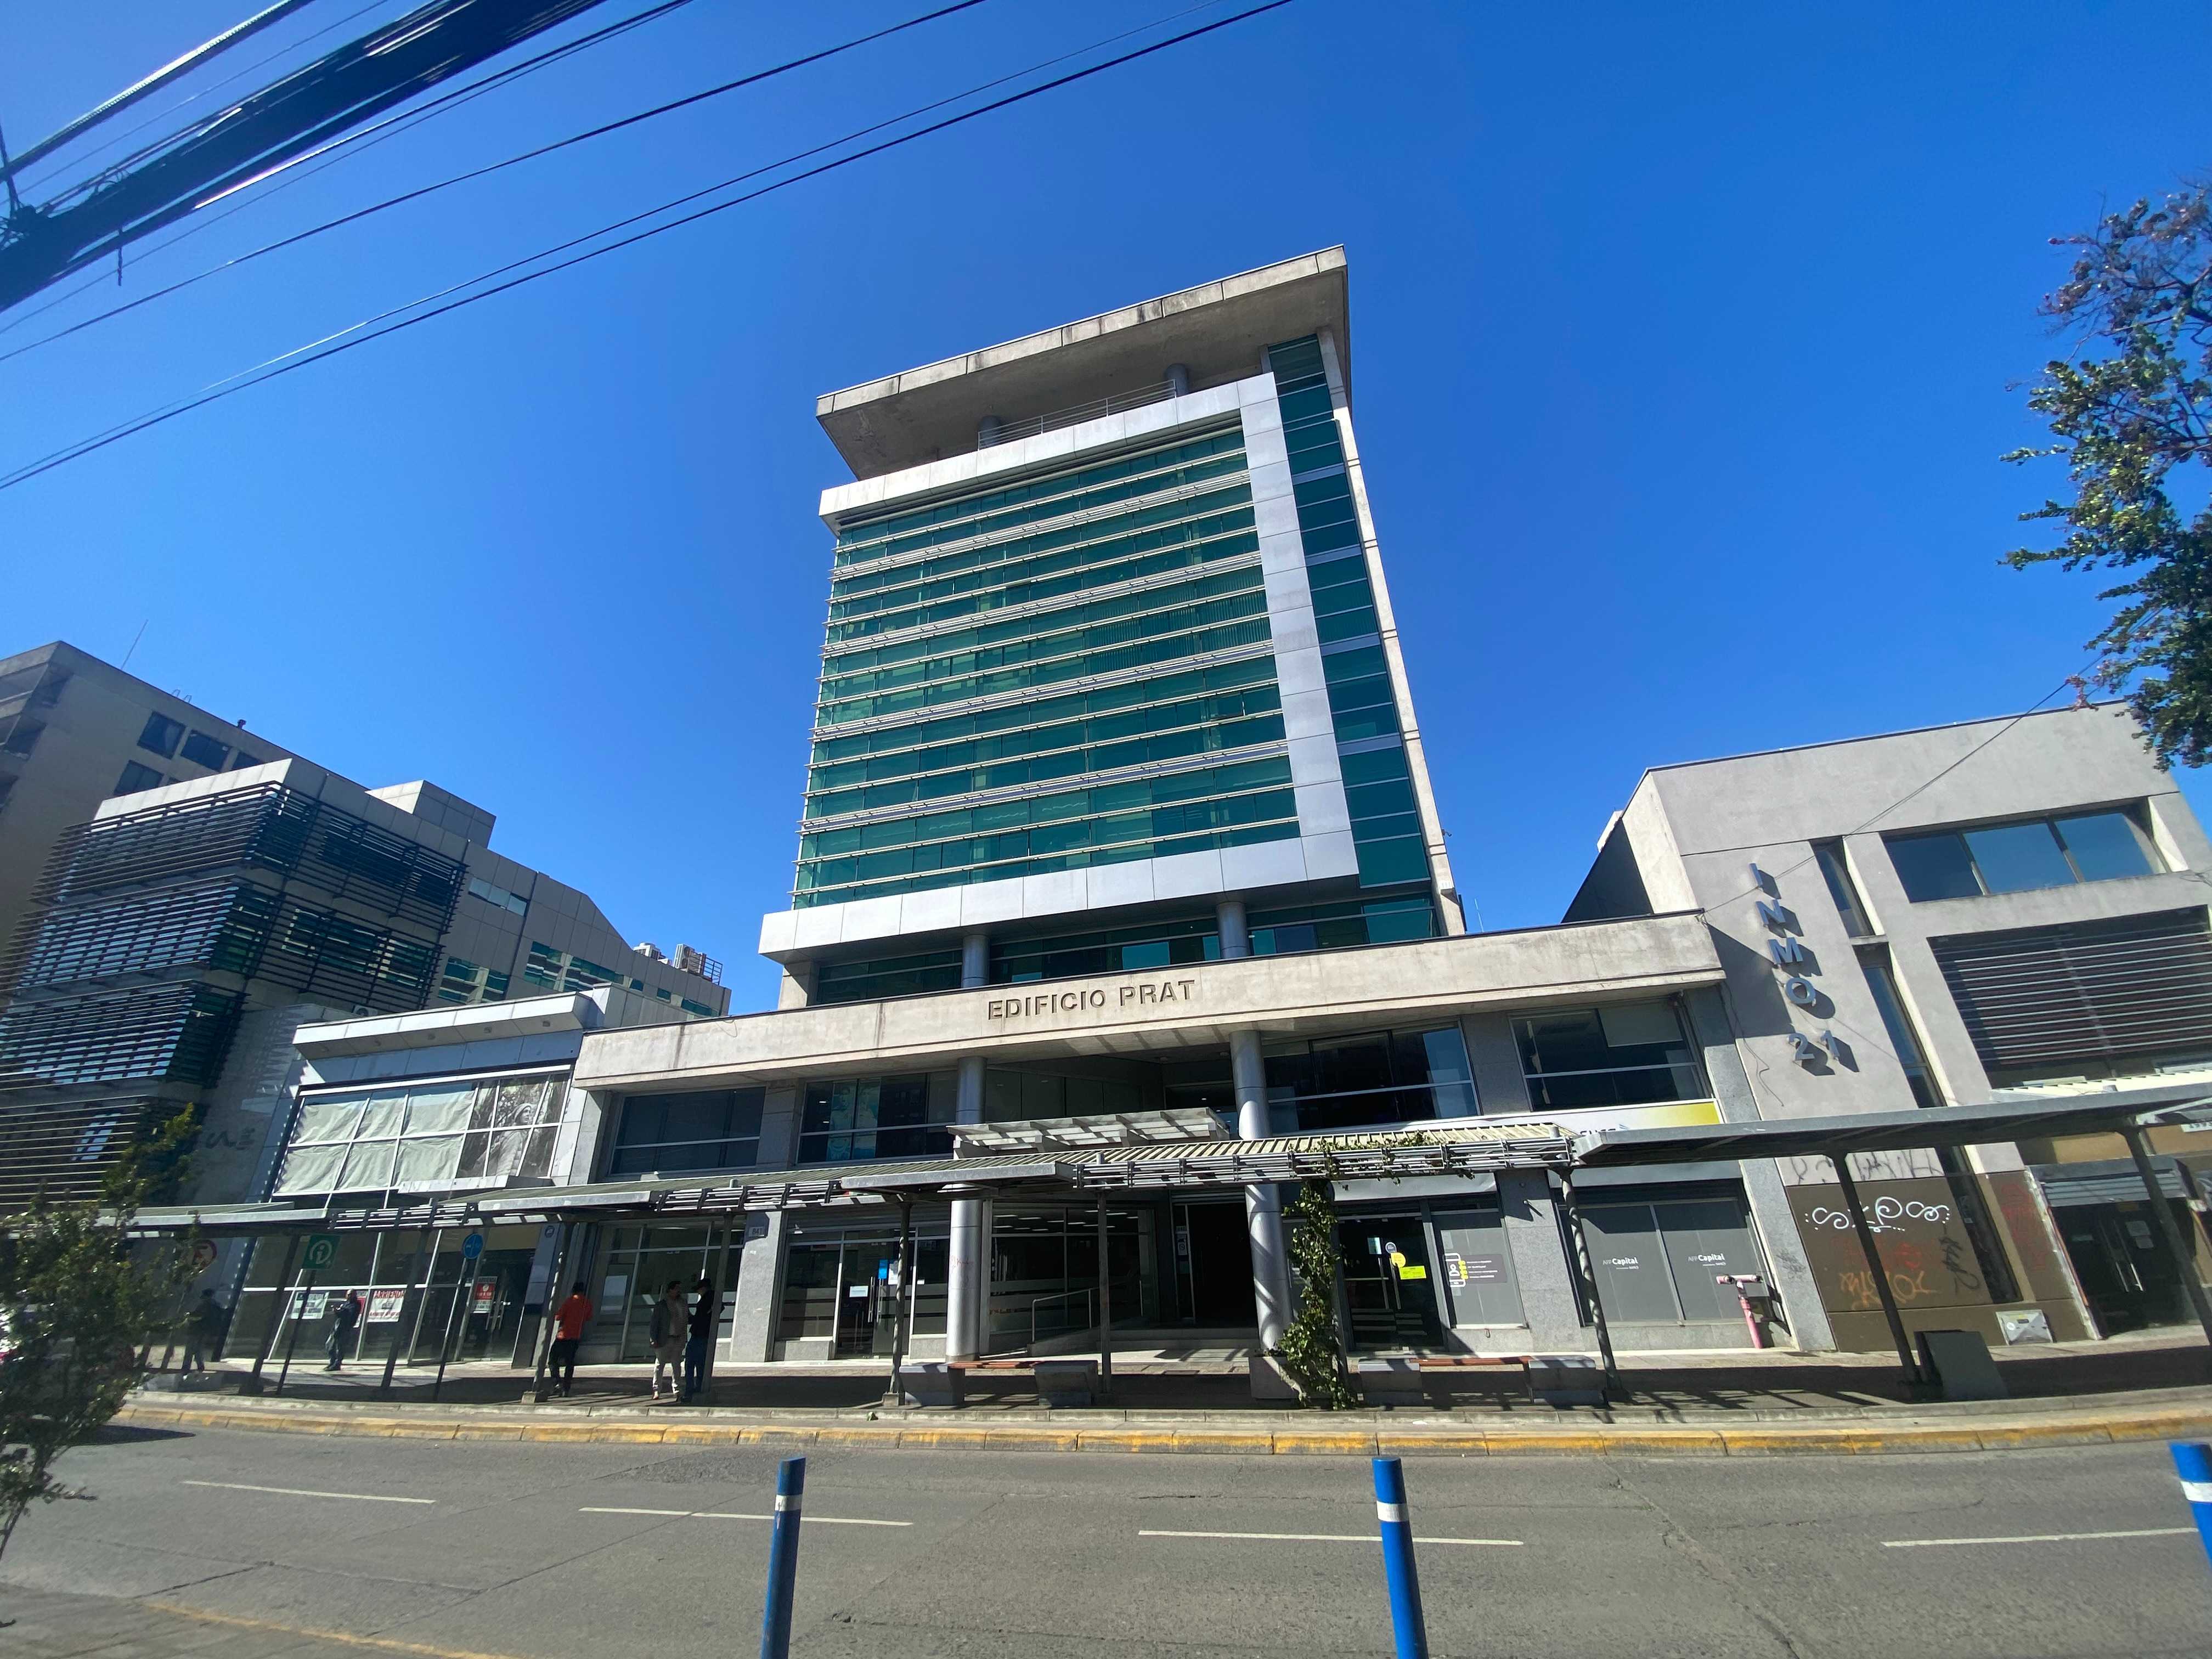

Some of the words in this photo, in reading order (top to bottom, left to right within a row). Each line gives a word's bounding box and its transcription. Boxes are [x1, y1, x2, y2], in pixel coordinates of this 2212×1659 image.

[1748, 862, 1816, 1005] INMO
[1788, 1030, 1841, 1062] 21
[988, 989, 1107, 1020] EDIFICIO
[1119, 979, 1195, 1007] PRAT
[1612, 1256, 1638, 1266] Capital
[1698, 1253, 1725, 1263] Capital
